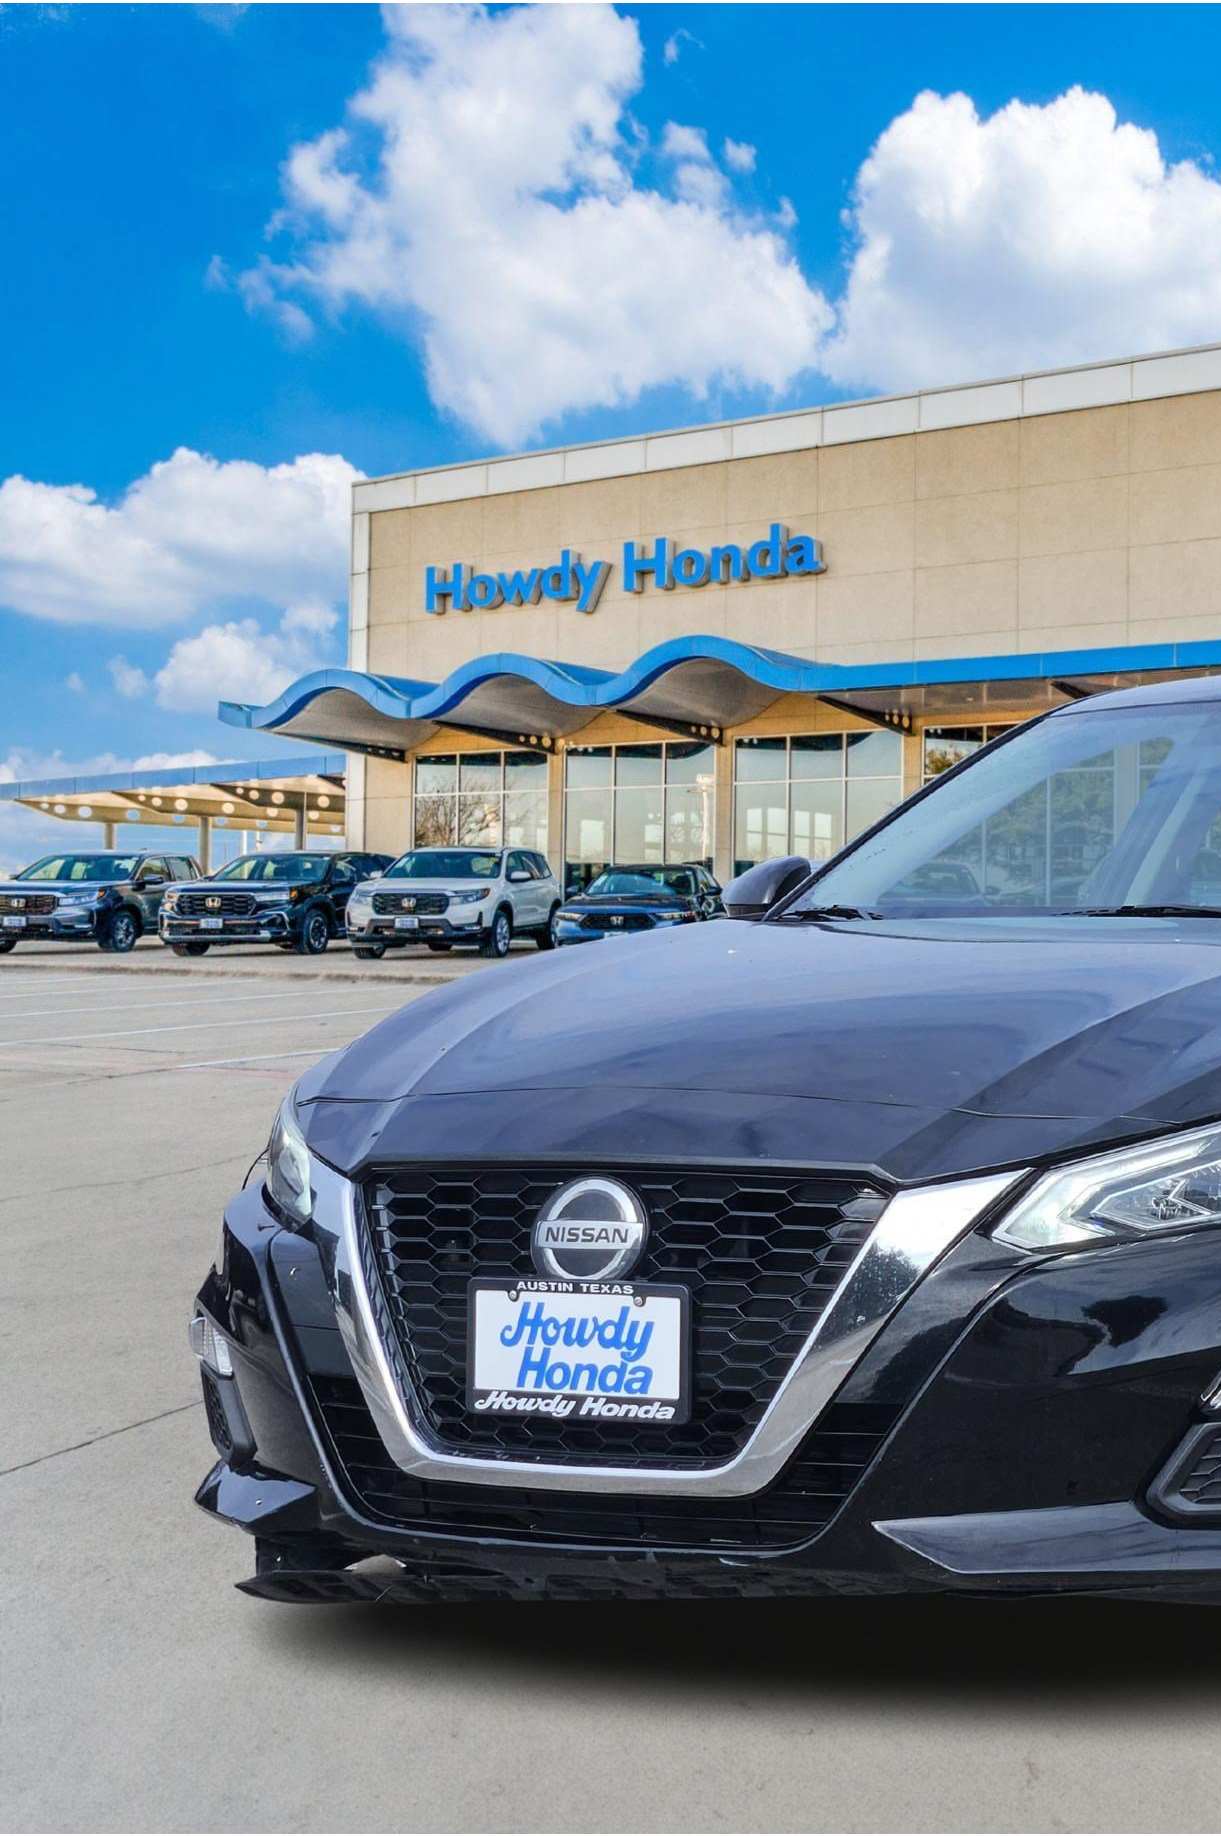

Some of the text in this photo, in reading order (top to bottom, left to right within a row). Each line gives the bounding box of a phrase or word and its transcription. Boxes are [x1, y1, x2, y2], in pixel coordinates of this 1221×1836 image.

[425, 523, 826, 614] Howdy Honda
[545, 1226, 629, 1244] NISSAN
[516, 1281, 634, 1294] AUSTIN TEXAS
[500, 1301, 655, 1362] Howdy
[516, 1346, 654, 1395] Honda
[474, 1391, 675, 1420] Howdy Honda
